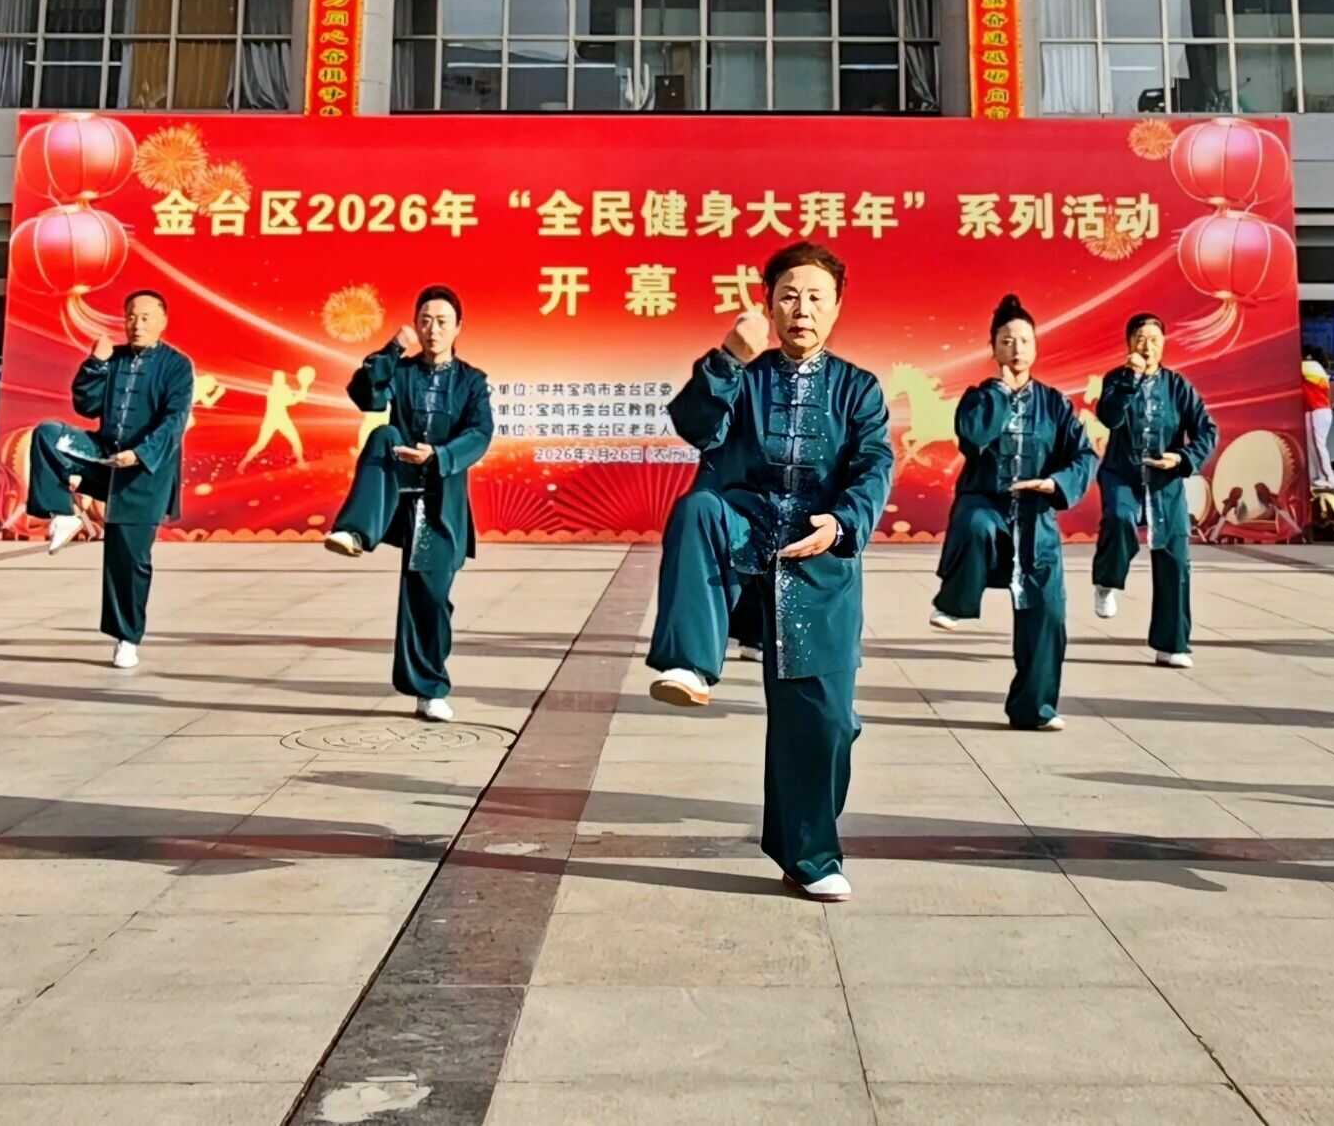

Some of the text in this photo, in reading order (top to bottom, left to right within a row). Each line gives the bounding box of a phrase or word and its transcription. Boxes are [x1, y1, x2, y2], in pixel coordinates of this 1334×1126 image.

[538, 264, 763, 316] 开幕式
[492, 382, 673, 397] 单位：中共宝鸡市金台区委
